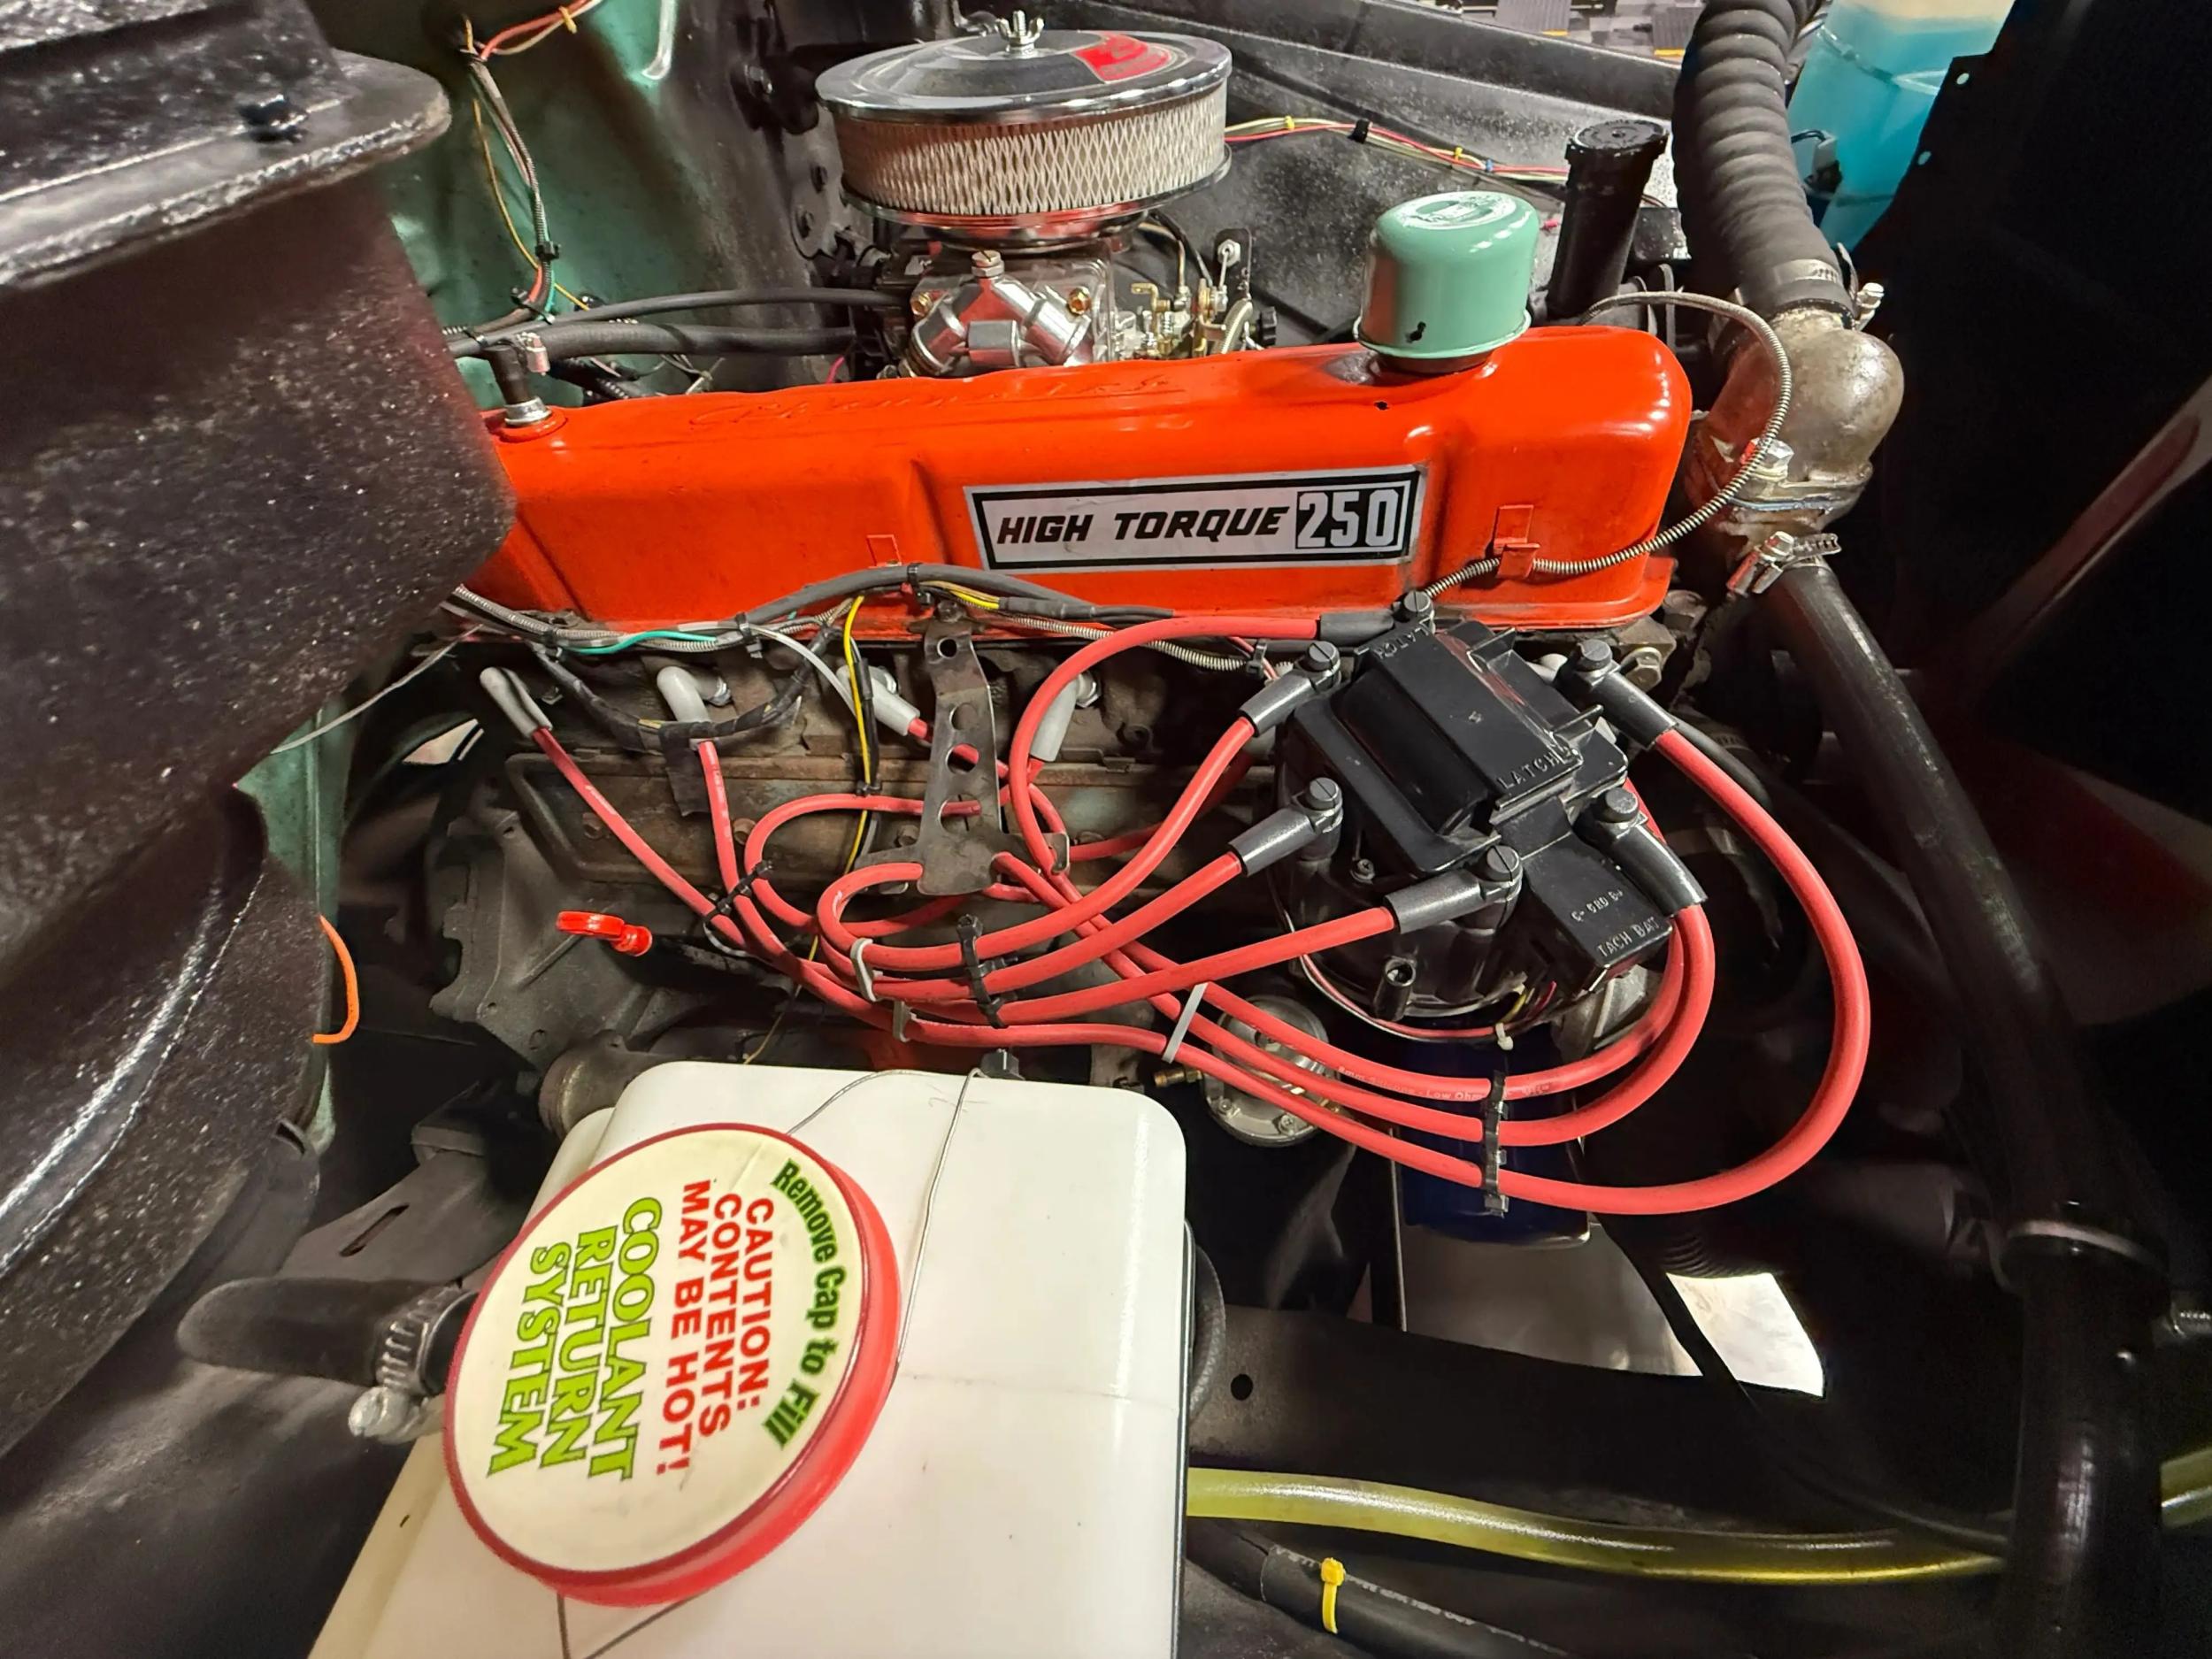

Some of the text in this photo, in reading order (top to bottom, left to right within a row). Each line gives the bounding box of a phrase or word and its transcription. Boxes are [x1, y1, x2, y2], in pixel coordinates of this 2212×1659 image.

[996, 488, 1401, 549] HIGH TORQUE 250
[1497, 751, 1560, 789] LATCH
[1597, 930, 1633, 956] TACH
[1425, 1087, 1452, 1101] Low
[486, 1240, 573, 1479] SYSTEM
[538, 1224, 618, 1469] RETURN
[587, 1195, 664, 1481] COOLANT
[656, 1179, 711, 1476] MAY BE HOT!
[697, 1193, 741, 1439] CONTENTS
[736, 1197, 774, 1412] CAUTION:
[761, 1158, 847, 1450] Remove Cap to Fill
